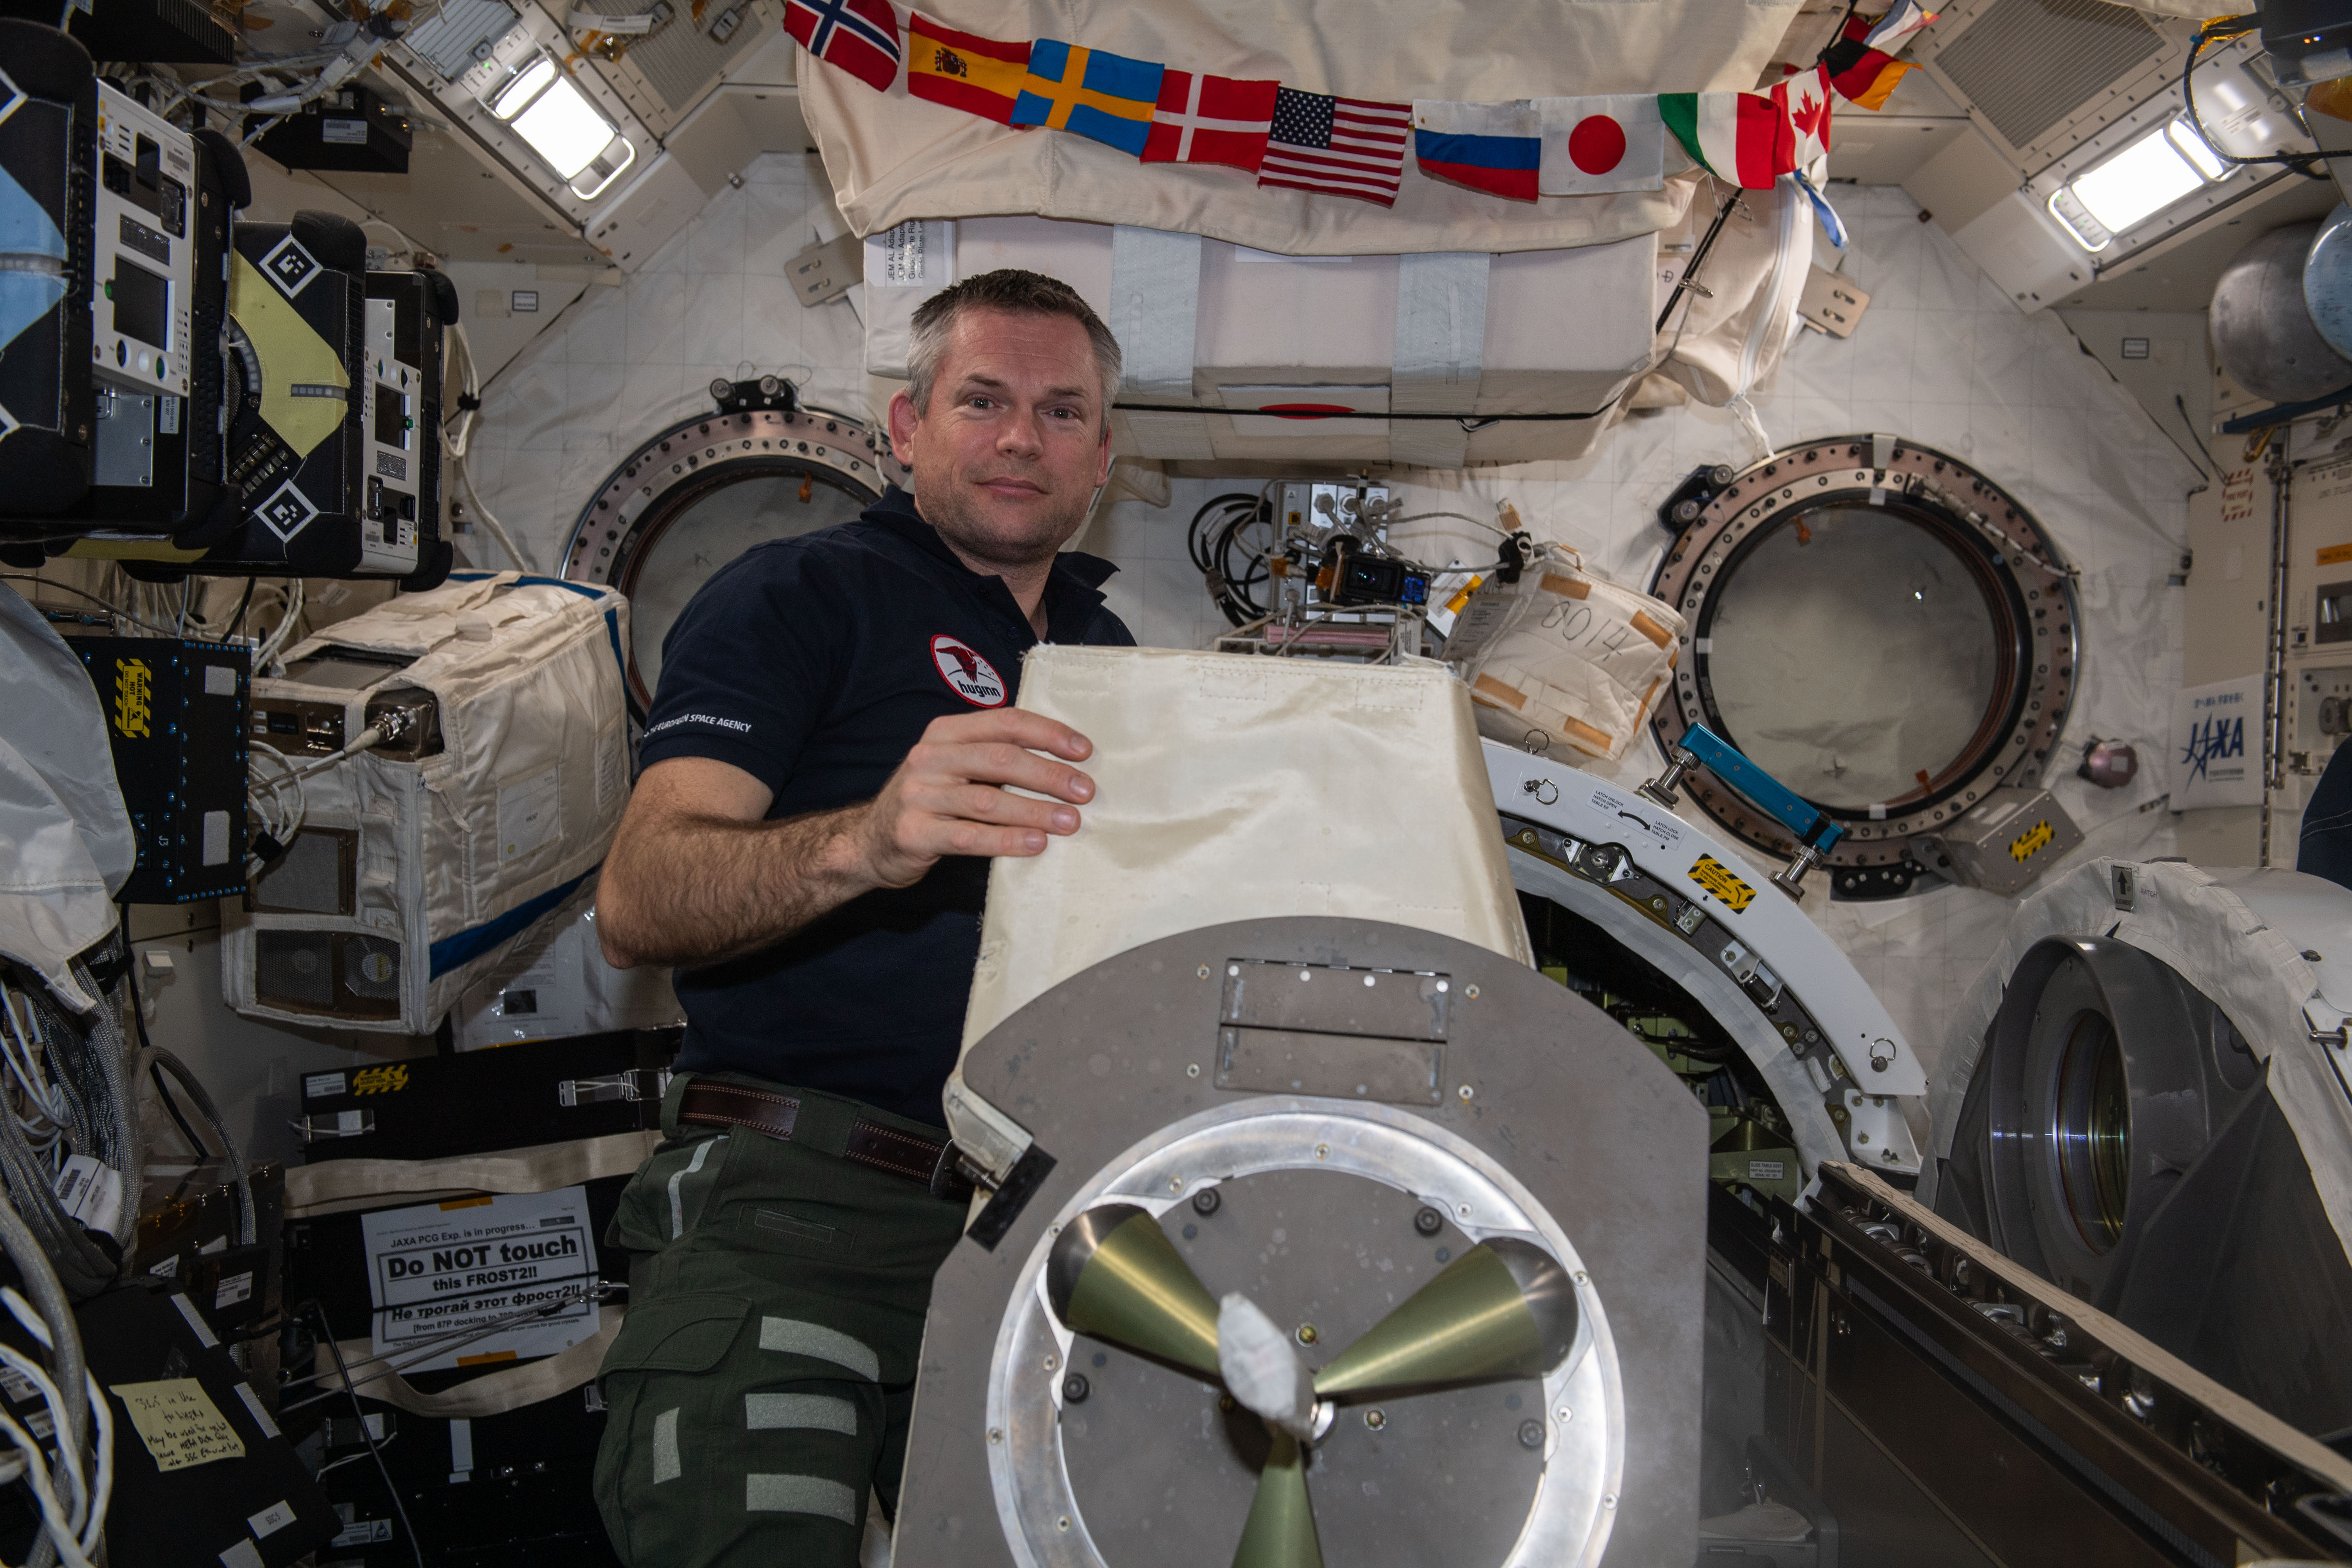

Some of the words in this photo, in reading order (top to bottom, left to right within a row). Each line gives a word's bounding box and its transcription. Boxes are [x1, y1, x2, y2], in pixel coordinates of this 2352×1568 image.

[888, 252, 894, 262] AL
[898, 250, 904, 260] AL
[1541, 601, 1629, 662] 0014
[957, 680, 1002, 697] huginn
[689, 714, 717, 725] SPACE
[716, 717, 751, 733] AGENCY
[1591, 799, 1603, 808] TABLE
[1593, 794, 1606, 803] HATCH
[1595, 790, 1608, 799] LATCH
[1608, 797, 1624, 807] UNLOCK
[1653, 825, 1666, 834] HATCH
[1666, 832, 1679, 840] CLOSE
[1655, 820, 1668, 830] LATCH
[159, 835, 169, 846] J3
[1651, 829, 1663, 838] TABLE
[1701, 869, 1717, 883] HARDWARE
[1717, 882, 1732, 894] SENSITIVE
[1704, 864, 1728, 883] CAUTION
[1708, 879, 1721, 890] LOADING
[2140, 887, 2157, 898] HATCH
[391, 1238, 416, 1248] JAXA
[418, 1233, 439, 1244] PCG
[441, 1232, 461, 1241] Exp.
[485, 1224, 535, 1236] progress...
[388, 1258, 425, 1278] Do
[433, 1245, 491, 1272] NOT
[499, 1235, 577, 1263] touch
[432, 1277, 461, 1291] this
[466, 1266, 537, 1286] FROST2!!
[392, 1308, 413, 1320] Не
[417, 1299, 469, 1319] трогай
[474, 1297, 508, 1309] этот
[414, 1323, 435, 1334] [from
[437, 1320, 452, 1329] 87P
[147, 1435, 166, 1448] May
[164, 1429, 177, 1438] be
[180, 1426, 196, 1436] used
